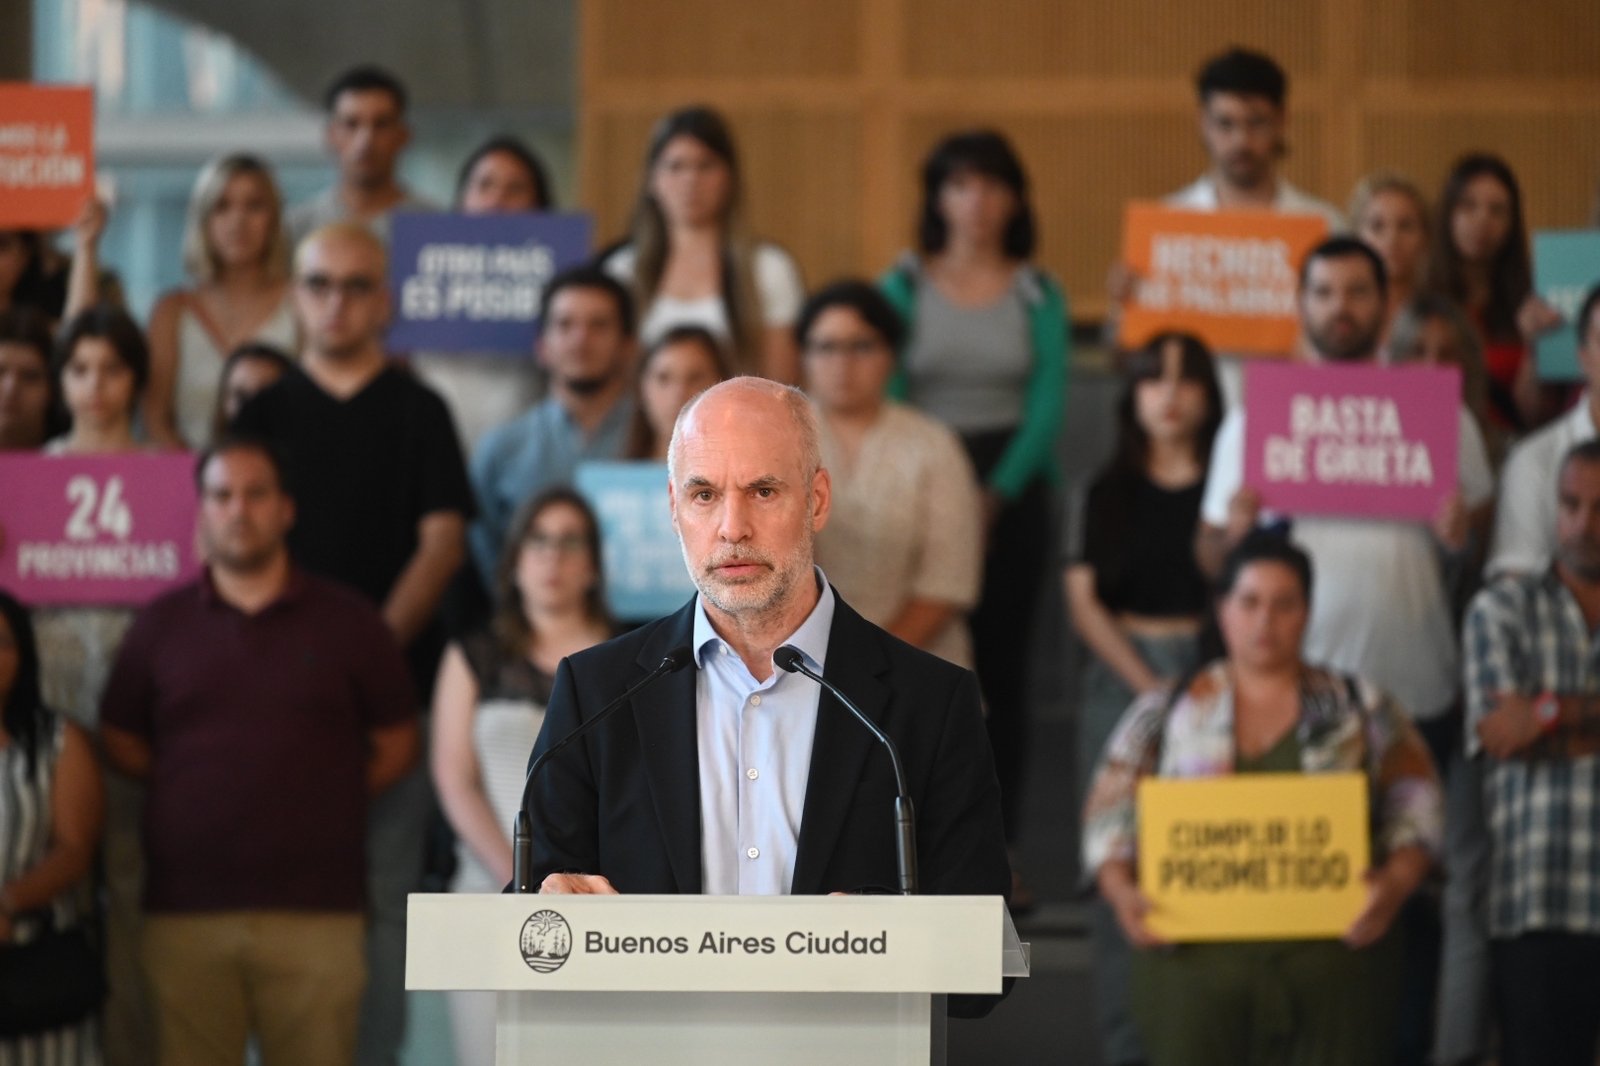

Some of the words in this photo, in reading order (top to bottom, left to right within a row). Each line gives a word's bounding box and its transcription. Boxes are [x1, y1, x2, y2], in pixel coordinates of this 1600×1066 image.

[403, 276, 440, 320] ES
[445, 281, 541, 322] POSIB
[1292, 396, 1400, 436] BASTA
[1265, 435, 1304, 482] DE
[1315, 440, 1433, 486] GRIETA
[66, 475, 131, 540] 24
[18, 541, 178, 579] PROVINCIAS
[1169, 820, 1289, 847] CUMPLIR
[1297, 816, 1330, 847] LO
[1159, 851, 1349, 892] PROMETIDO
[585, 930, 689, 954] Buenos
[698, 930, 776, 954] Aires
[785, 930, 887, 954] Ciudad
